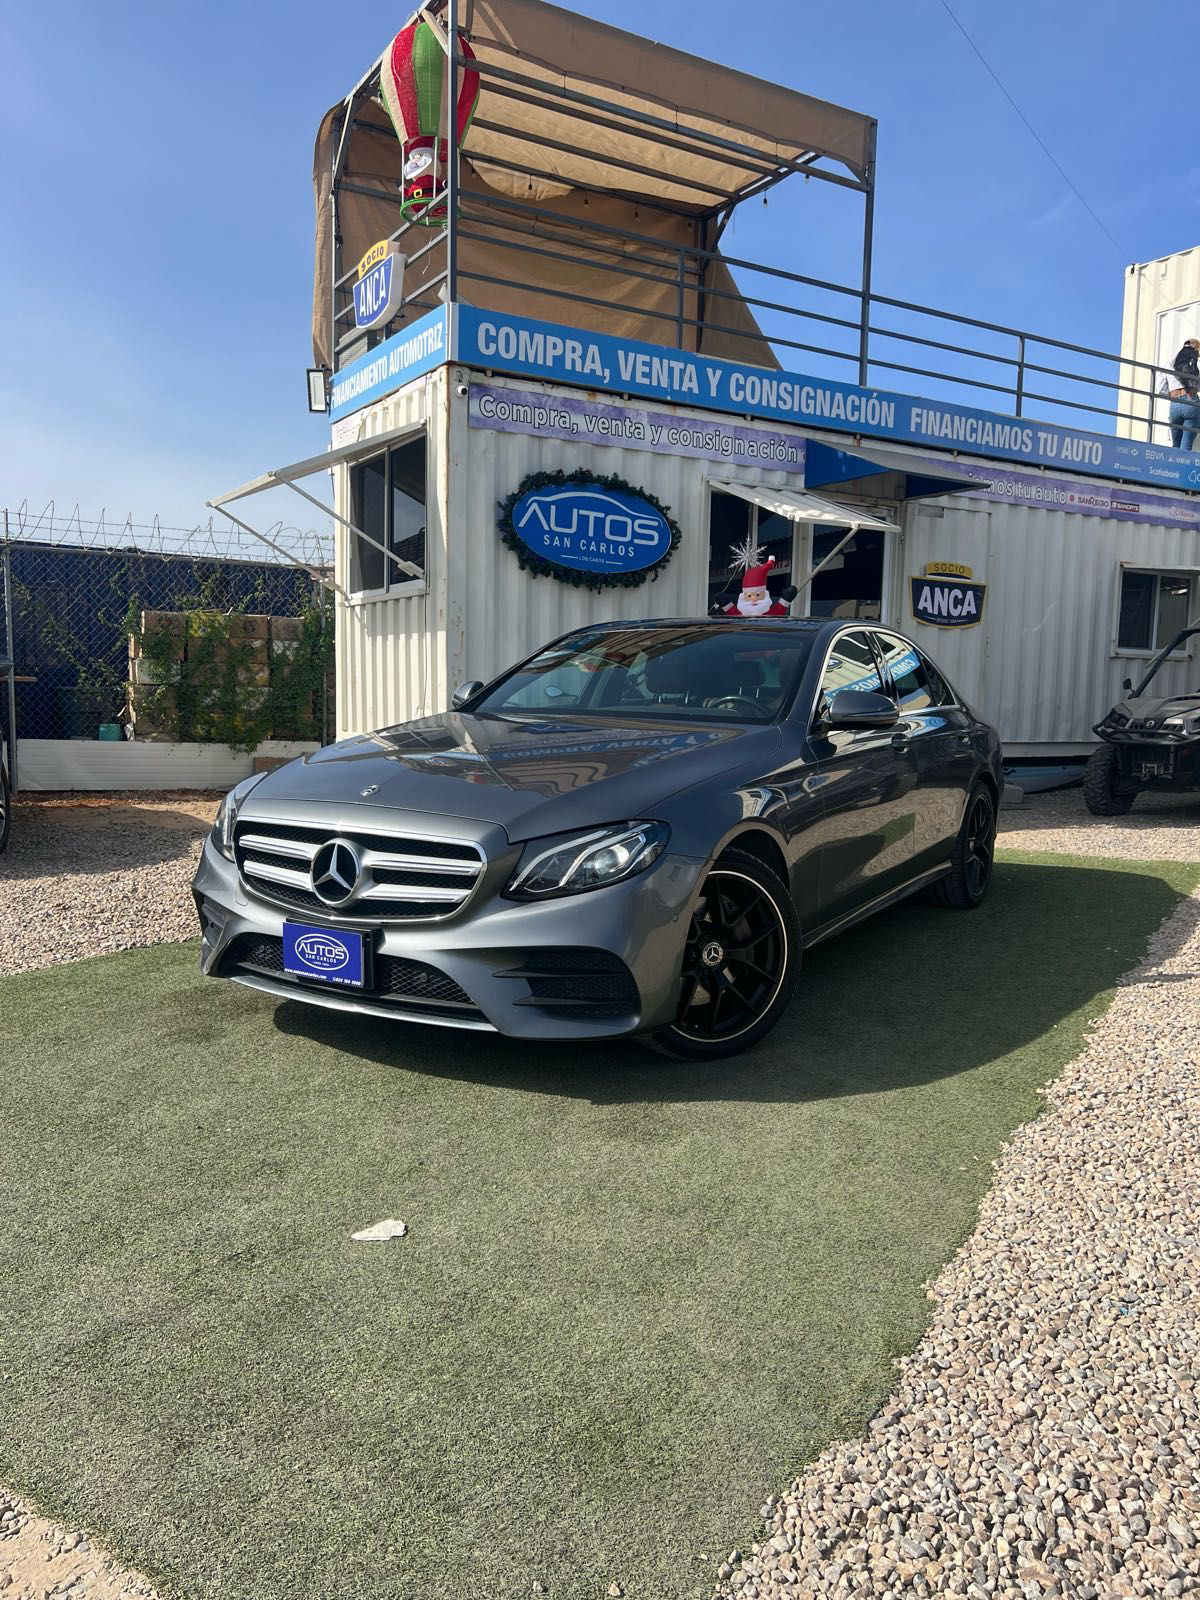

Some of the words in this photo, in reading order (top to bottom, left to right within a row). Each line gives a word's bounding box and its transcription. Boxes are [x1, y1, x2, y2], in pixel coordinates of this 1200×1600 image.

[361, 246, 384, 272] SOCIO
[360, 266, 386, 317] ANCA
[389, 321, 443, 377] AUTOMOTRIZ
[477, 322, 610, 384] COMPRA,
[617, 350, 699, 394] VENTA
[706, 367, 723, 397] Y
[729, 372, 895, 429] CONSIGNACIÓN
[478, 394, 579, 435] Compra,
[583, 411, 646, 441] venta
[649, 425, 664, 445] y
[667, 425, 799, 467] consignación
[910, 407, 1033, 453] FINANCIAMOS
[1037, 431, 1056, 457] TU
[1061, 436, 1103, 466] AUTO
[1017, 482, 1034, 499] tu
[1036, 487, 1067, 505] auto
[518, 502, 660, 546] AUTOS
[543, 534, 571, 548] SAN
[580, 539, 635, 558] CARLOS
[934, 563, 965, 574] SOCIO
[917, 585, 977, 617] ANCA
[298, 943, 346, 960] AUTOS
[316, 954, 337, 964] CARLOS
